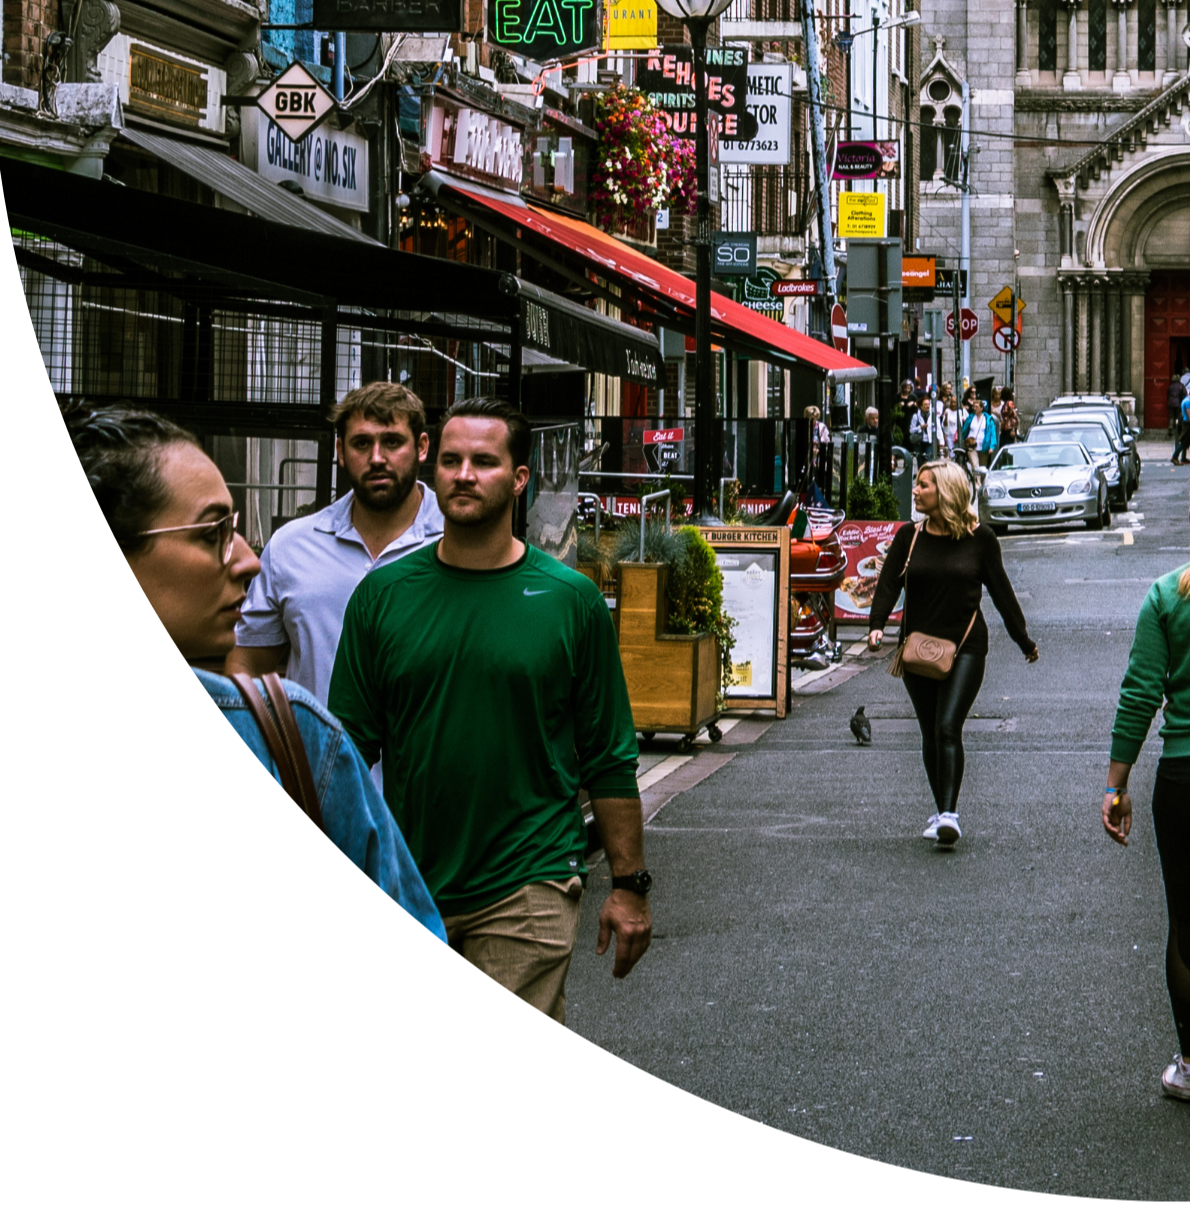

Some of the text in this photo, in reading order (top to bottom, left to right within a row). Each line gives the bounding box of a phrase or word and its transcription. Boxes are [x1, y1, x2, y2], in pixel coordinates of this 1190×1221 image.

[613, 9, 652, 20] URANT
[705, 49, 744, 66] INES
[275, 92, 316, 113] GBK
[723, 140, 778, 151] 01 6773623
[314, 136, 323, 182] @
[837, 153, 875, 163] Victoria
[717, 247, 749, 262] SO
[777, 284, 815, 293] Ladbrokes
[948, 319, 977, 330] SOP
[663, 451, 678, 459] BEAT
[712, 532, 742, 541] BURGER
[744, 532, 778, 541] KITCHEN
